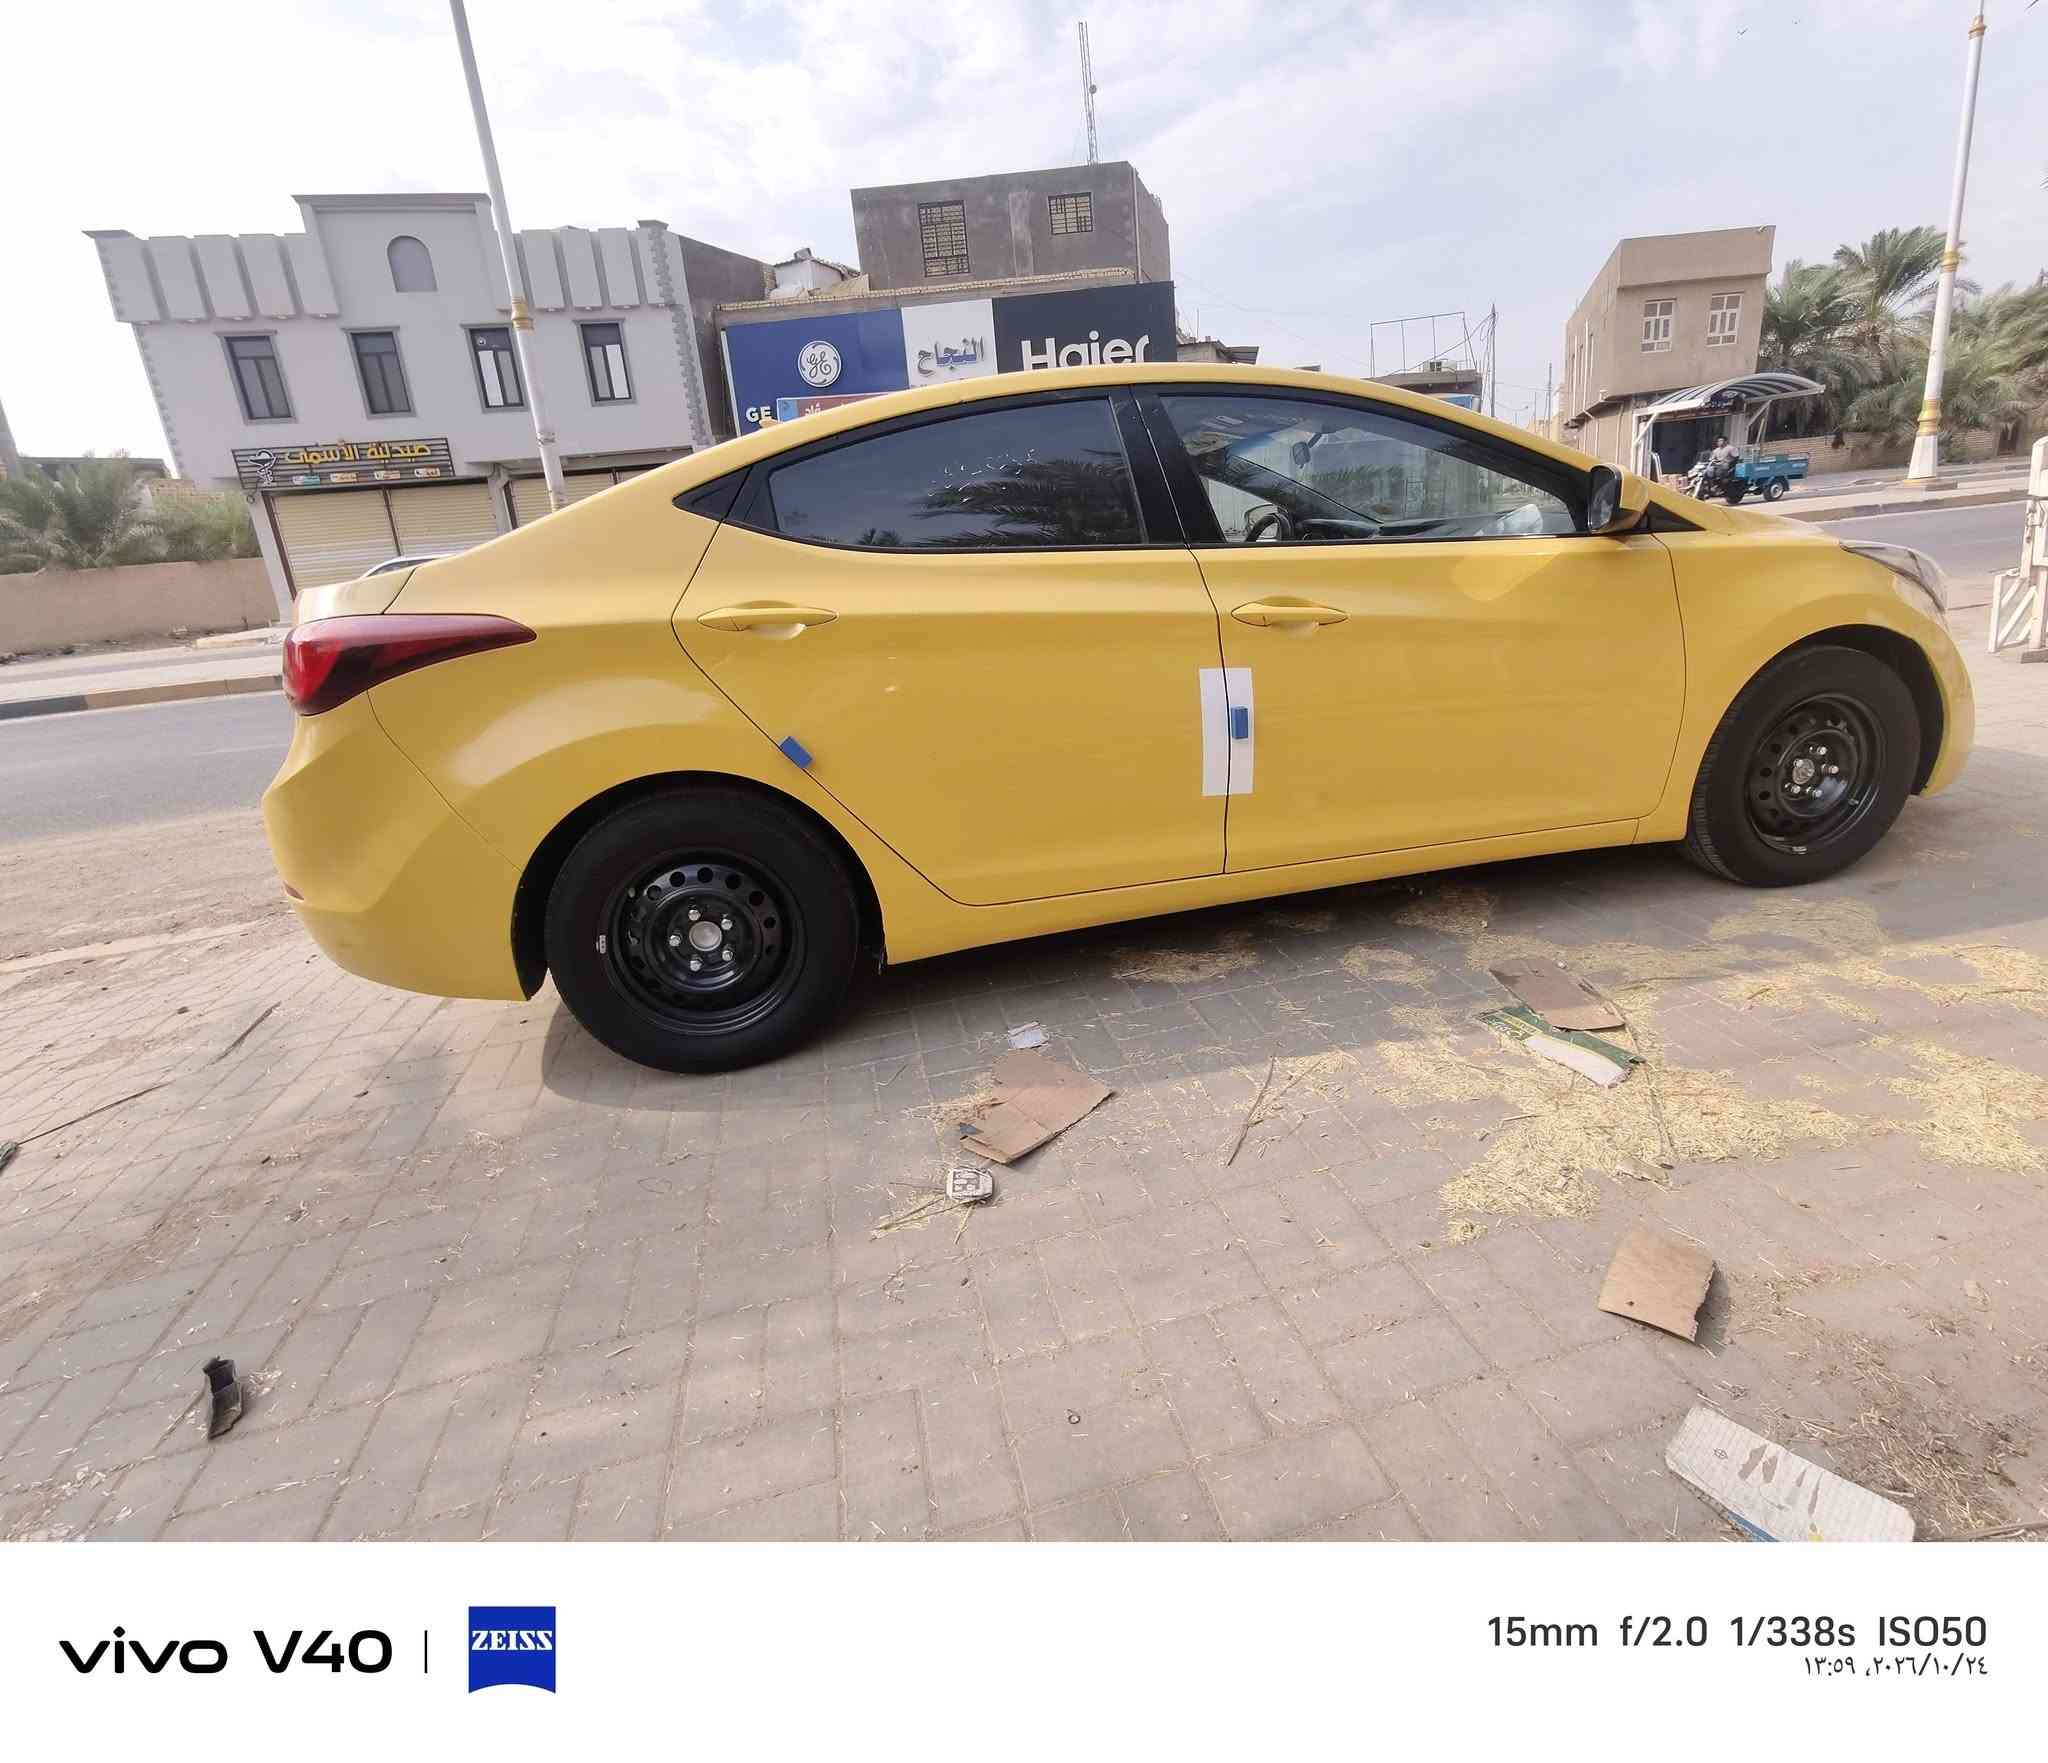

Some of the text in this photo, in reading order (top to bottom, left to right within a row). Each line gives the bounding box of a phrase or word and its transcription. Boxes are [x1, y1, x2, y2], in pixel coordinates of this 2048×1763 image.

[917, 336, 985, 375] النجاح
[1021, 330, 1150, 370] Haier
[745, 405, 772, 422] GE
[367, 441, 432, 463] صيدلية
